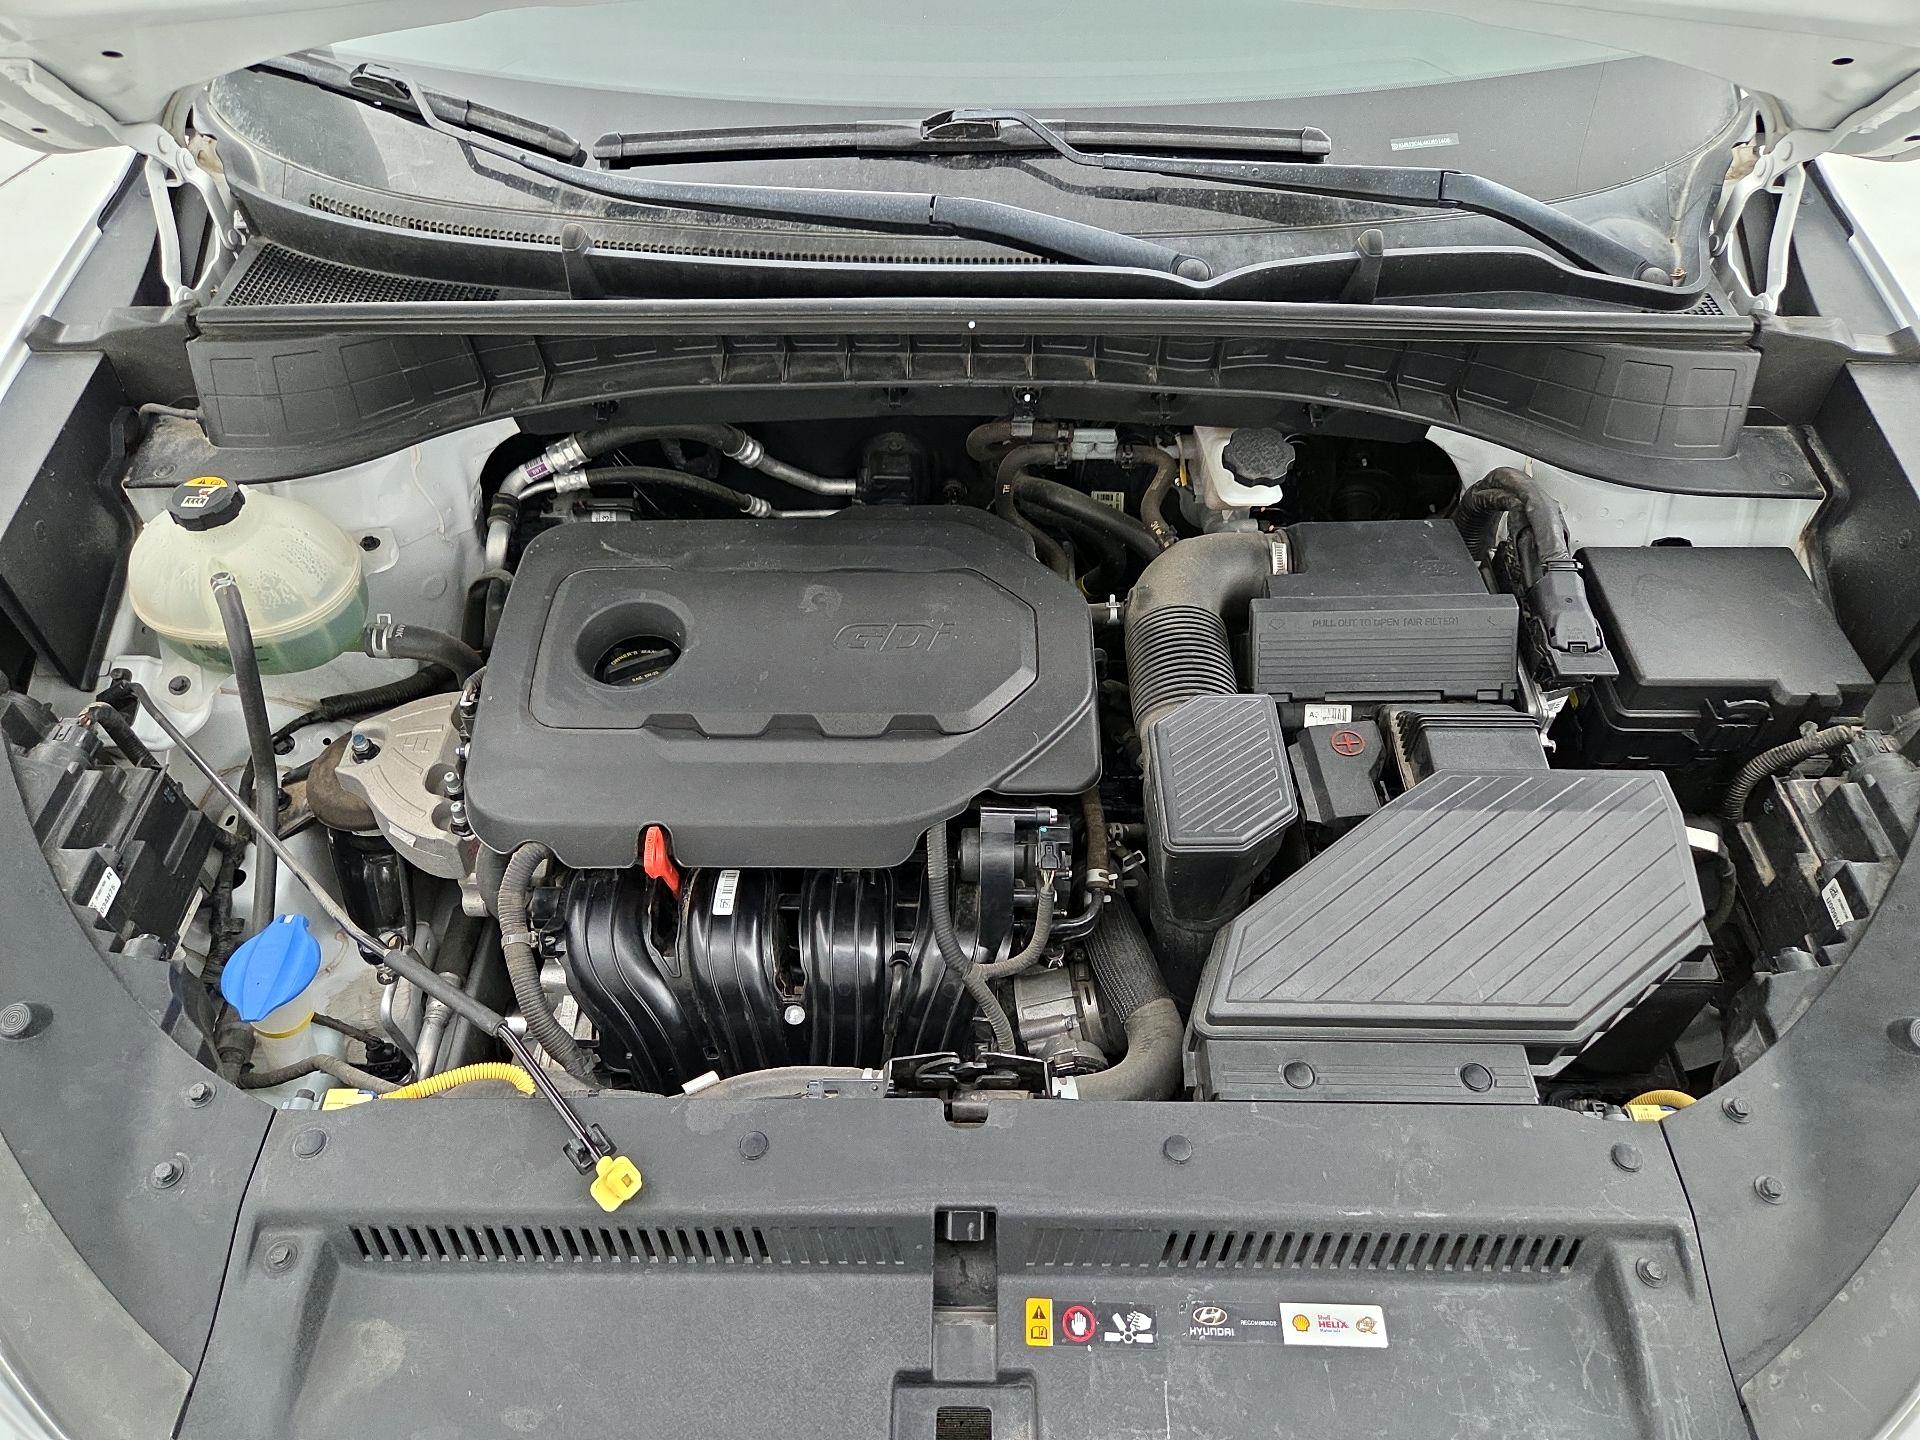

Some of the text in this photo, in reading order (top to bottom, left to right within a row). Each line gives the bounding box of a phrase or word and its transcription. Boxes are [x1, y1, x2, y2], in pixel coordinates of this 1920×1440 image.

[1312, 619, 1336, 628] PULL
[1338, 618, 1357, 627] OUT
[1360, 618, 1371, 627] TO
[1373, 618, 1399, 627] OPEN
[1318, 1319, 1350, 1329] HELIX
[1189, 1326, 1235, 1337] HYUNDAI
